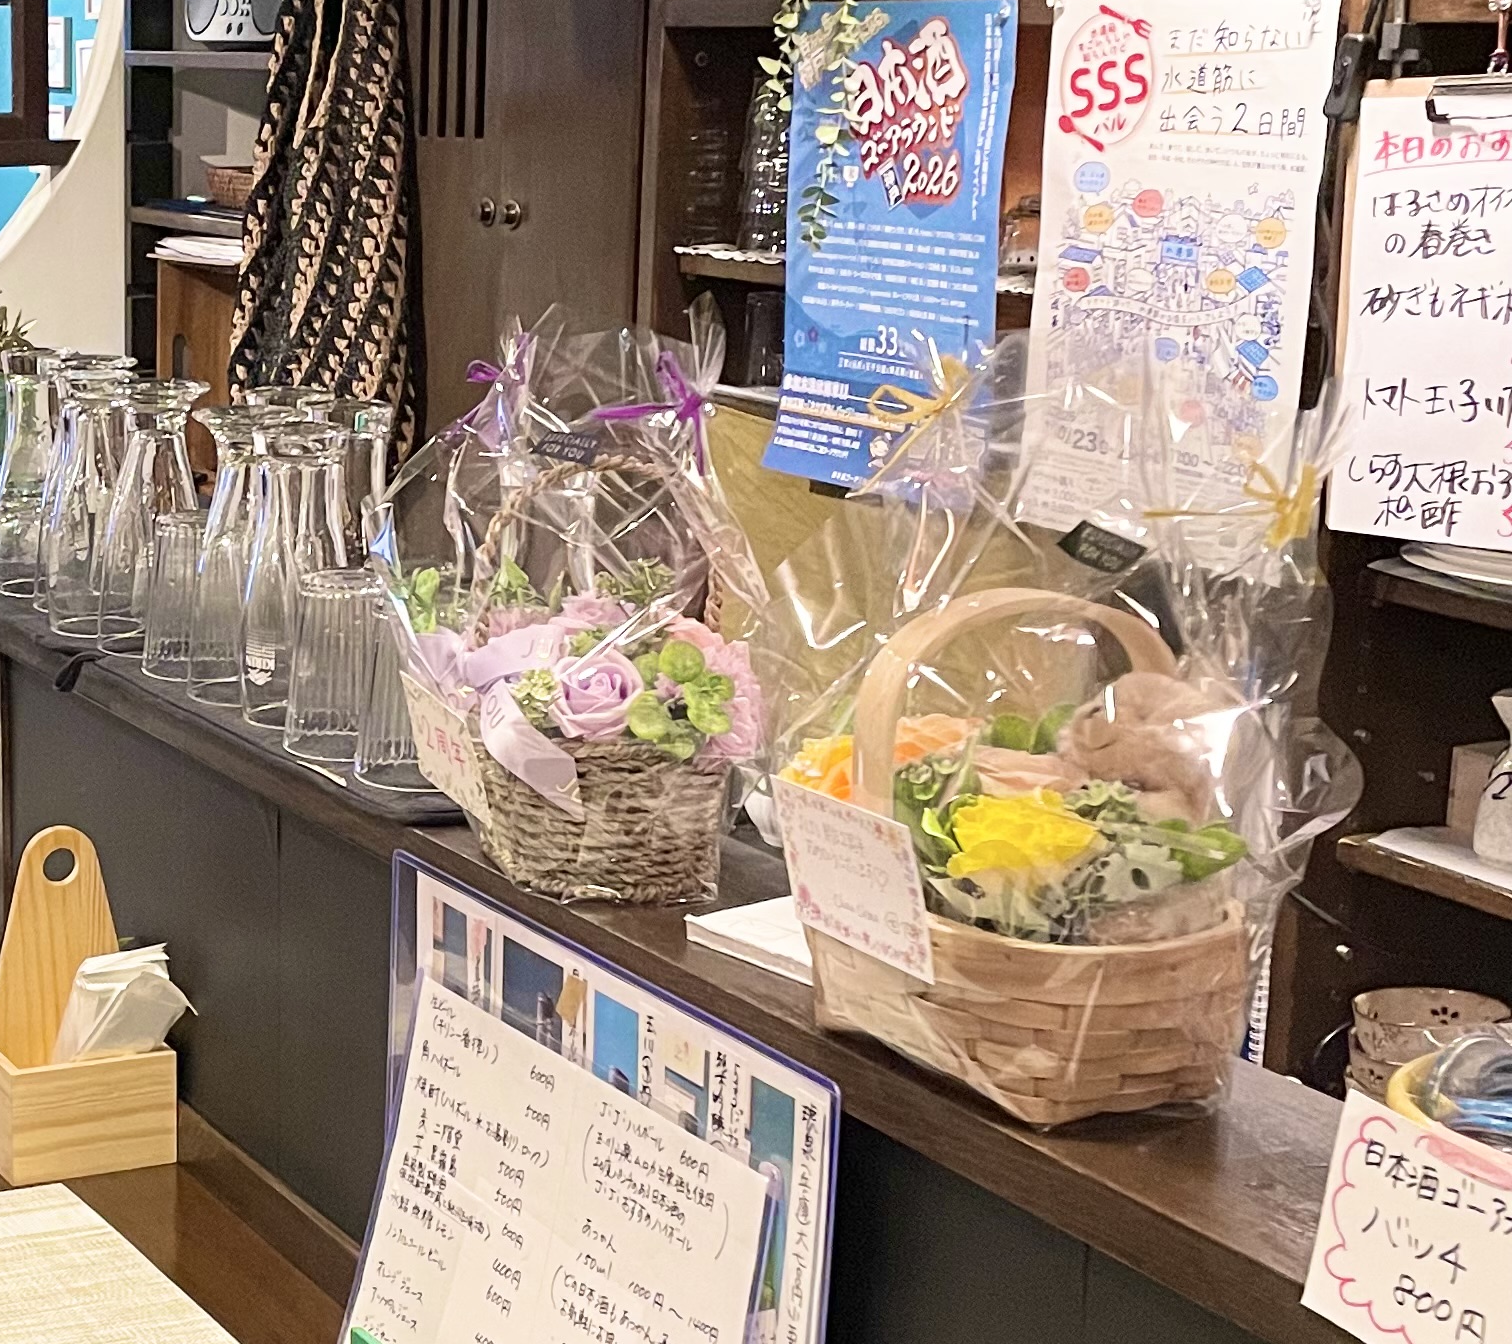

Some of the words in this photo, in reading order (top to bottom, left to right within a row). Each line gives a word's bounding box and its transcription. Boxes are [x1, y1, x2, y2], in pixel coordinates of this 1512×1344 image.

[1169, 19, 1302, 53] まだ知らない
[1070, 53, 1149, 118] SSS
[1161, 62, 1256, 96] 水道筋に
[861, 104, 960, 171] ゴーアラウンド
[1159, 102, 1307, 141] 出会う2日間
[903, 153, 959, 198] 2026
[1384, 219, 1496, 258] の春巻き
